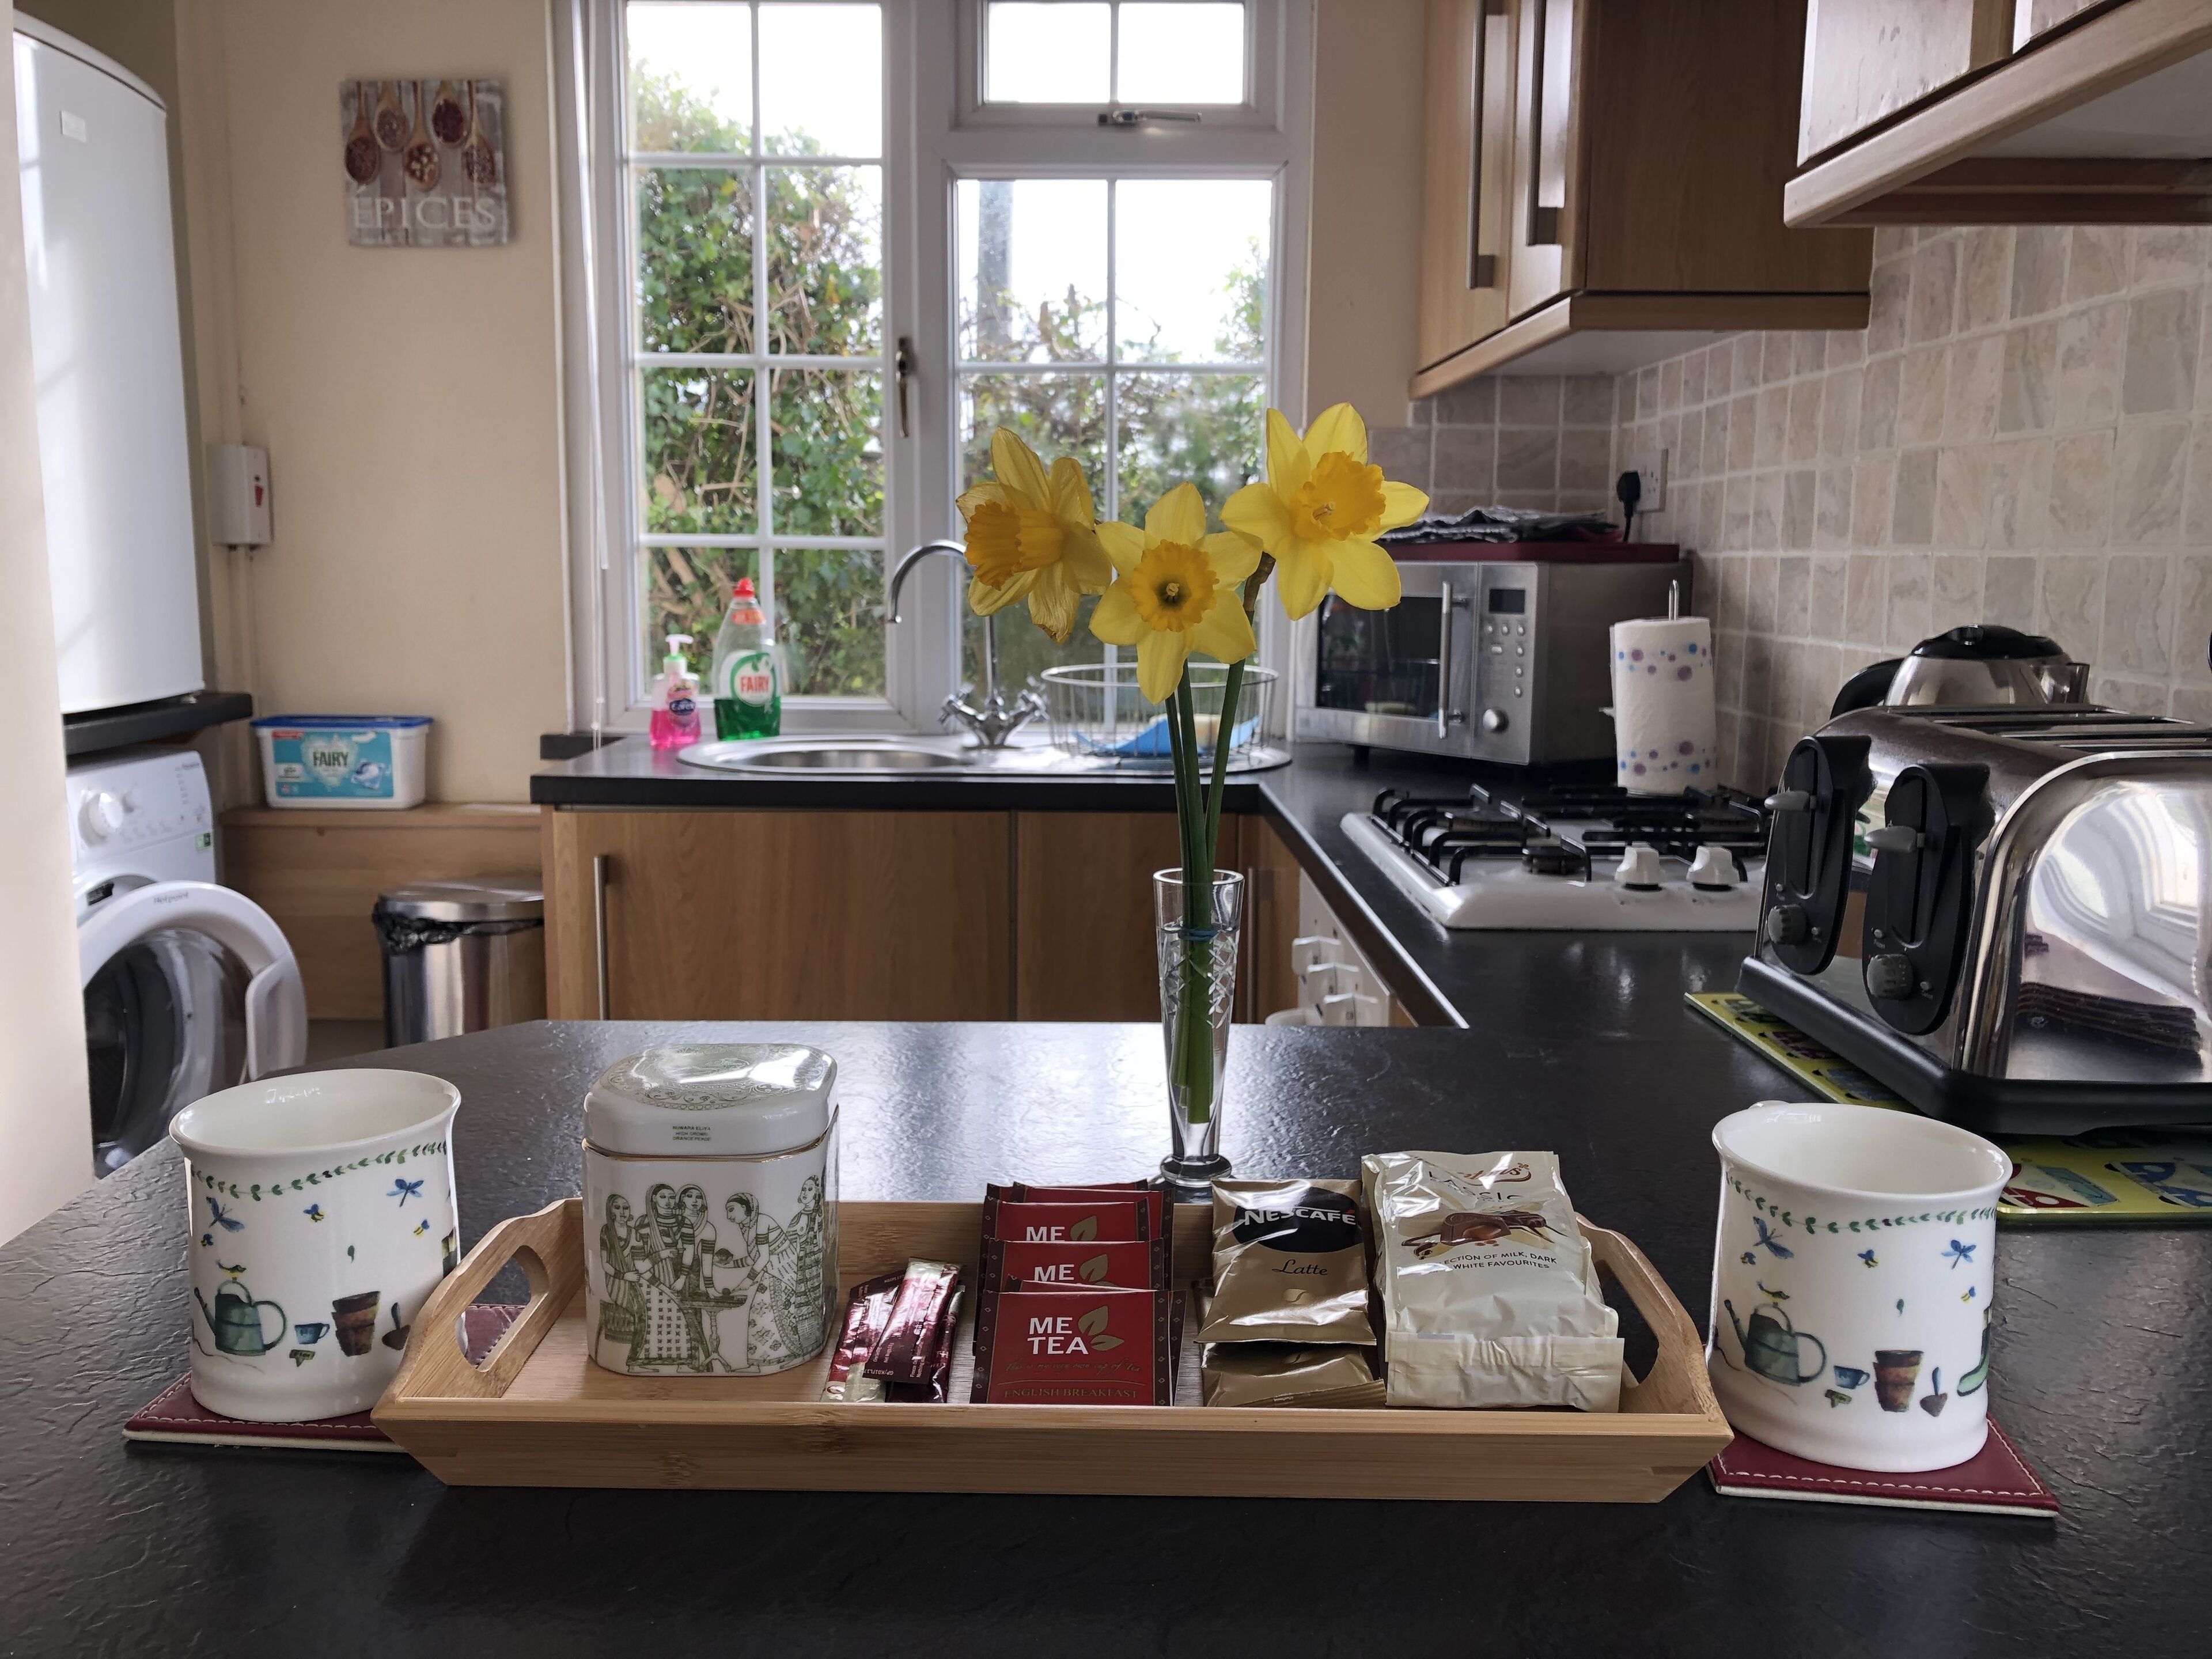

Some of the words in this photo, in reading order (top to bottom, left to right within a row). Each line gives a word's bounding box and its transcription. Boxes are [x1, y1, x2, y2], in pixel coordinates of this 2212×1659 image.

[740, 676, 770, 692] FAIRY
[313, 751, 349, 767] FAIRY
[1026, 1226, 1065, 1241] ME
[1488, 1260, 1550, 1268] FAVOURITES
[1530, 1253, 1557, 1264] DARK
[1034, 1264, 1075, 1282] ME
[1271, 1259, 1328, 1276] Latte
[1029, 1317, 1073, 1335] ME
[1027, 1336, 1089, 1355] TEA
[1111, 1358, 1129, 1373] of
[1005, 1388, 1059, 1398] ENGLISH
[1063, 1388, 1137, 1399] BREAKFAST
